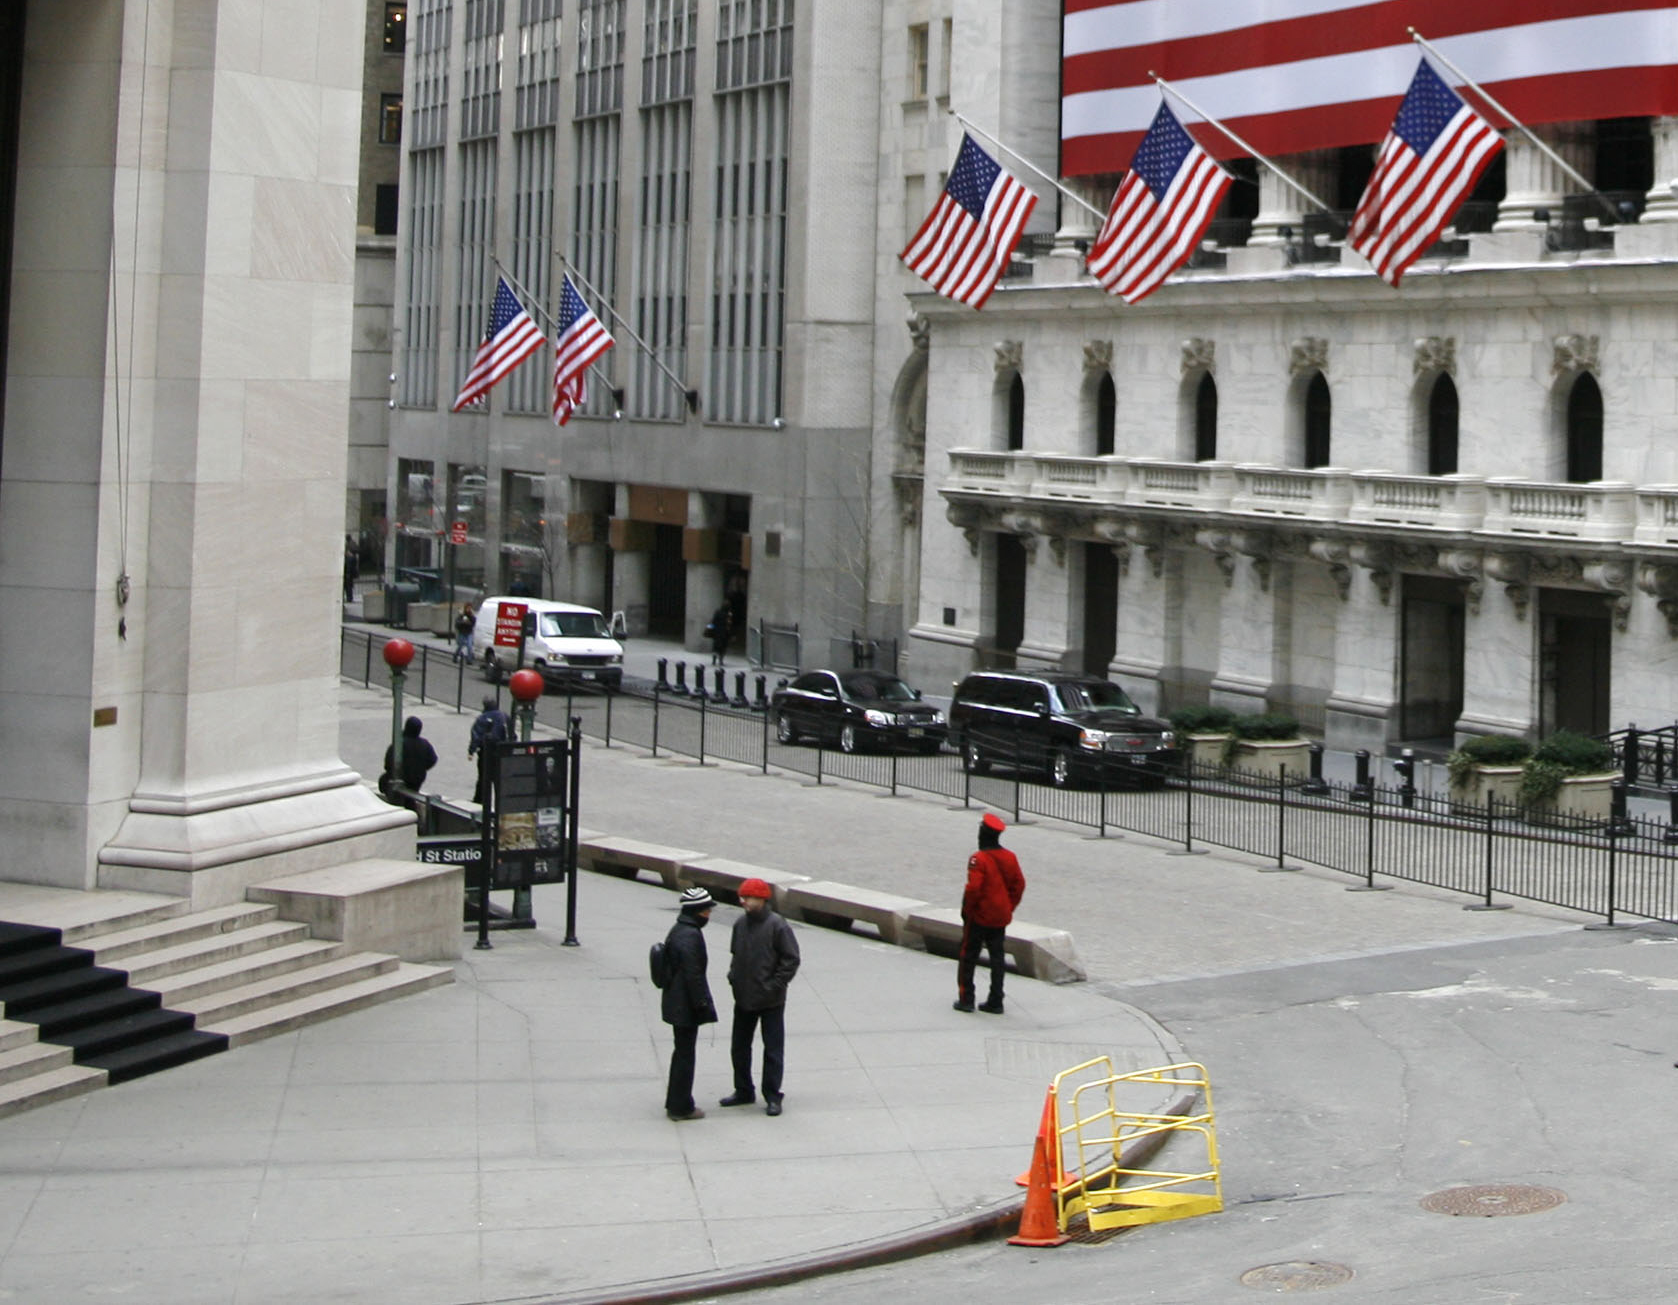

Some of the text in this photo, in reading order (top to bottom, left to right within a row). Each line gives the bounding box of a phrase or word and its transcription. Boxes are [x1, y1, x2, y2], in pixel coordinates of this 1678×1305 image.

[506, 606, 519, 616] NO
[497, 617, 522, 627] STANDIN
[497, 628, 521, 637] ANYTIM
[426, 850, 440, 863] St
[443, 848, 482, 862] Statio
